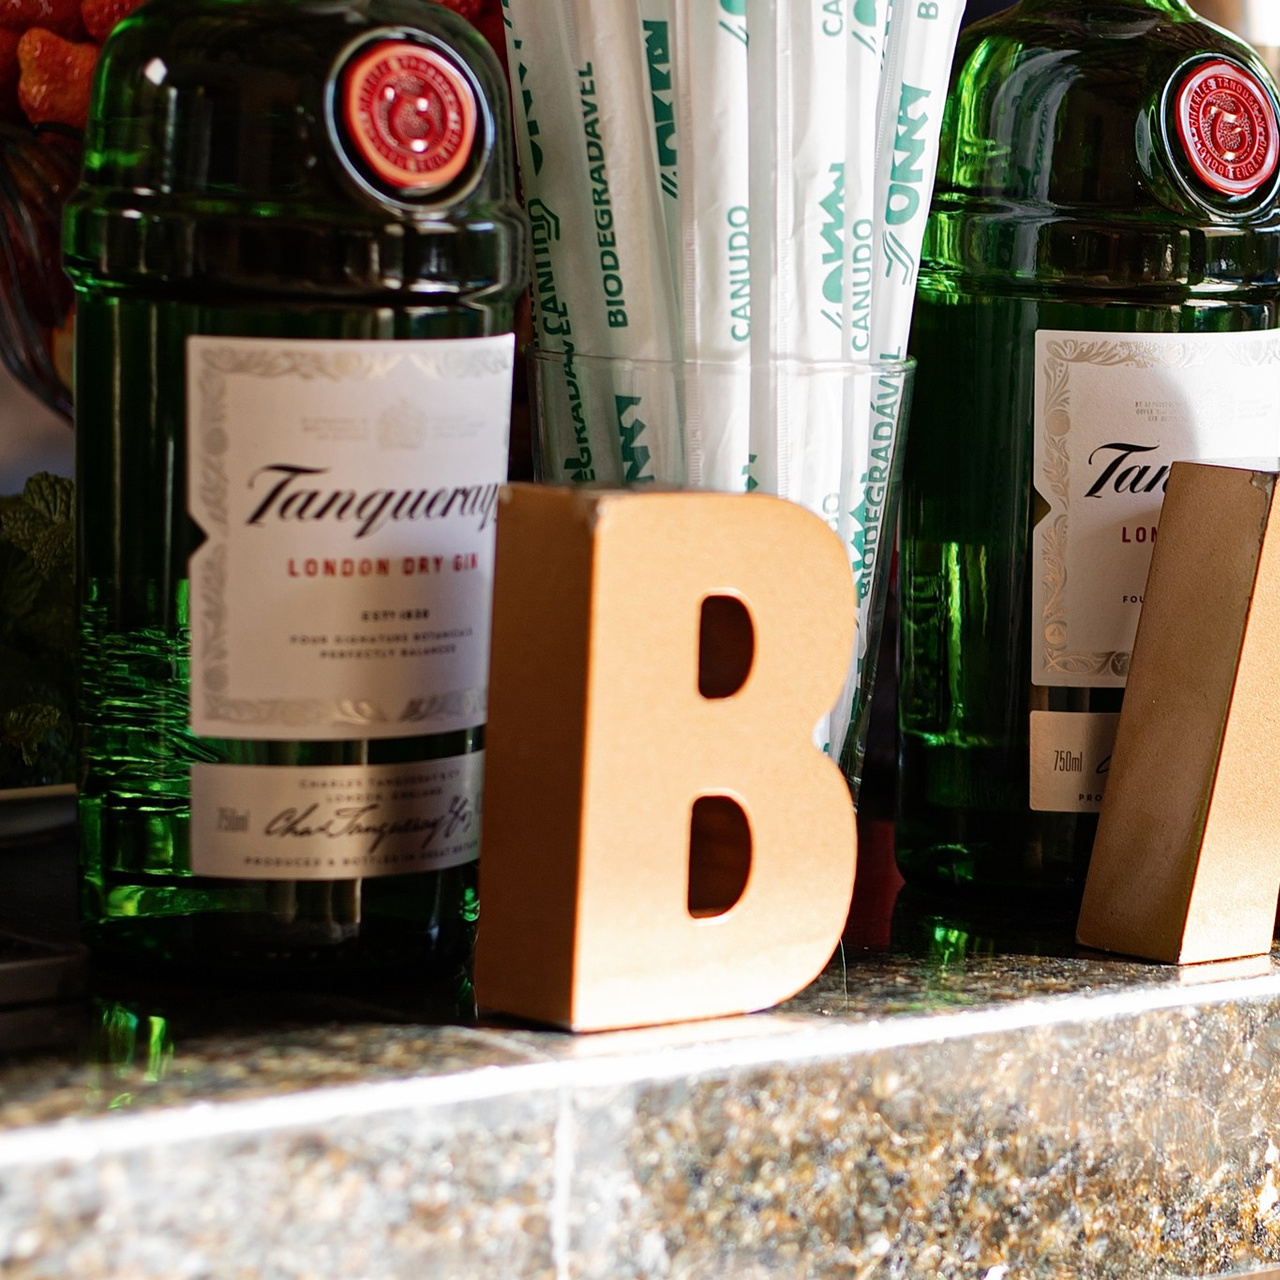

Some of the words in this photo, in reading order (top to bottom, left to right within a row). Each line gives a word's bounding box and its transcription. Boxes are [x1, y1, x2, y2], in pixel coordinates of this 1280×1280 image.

[851, 217, 874, 353] CANUDO
[245, 462, 498, 540] Tanqueray
[287, 558, 390, 578] LONDON
[404, 555, 443, 576] DRY
[1053, 749, 1083, 773] 750ml
